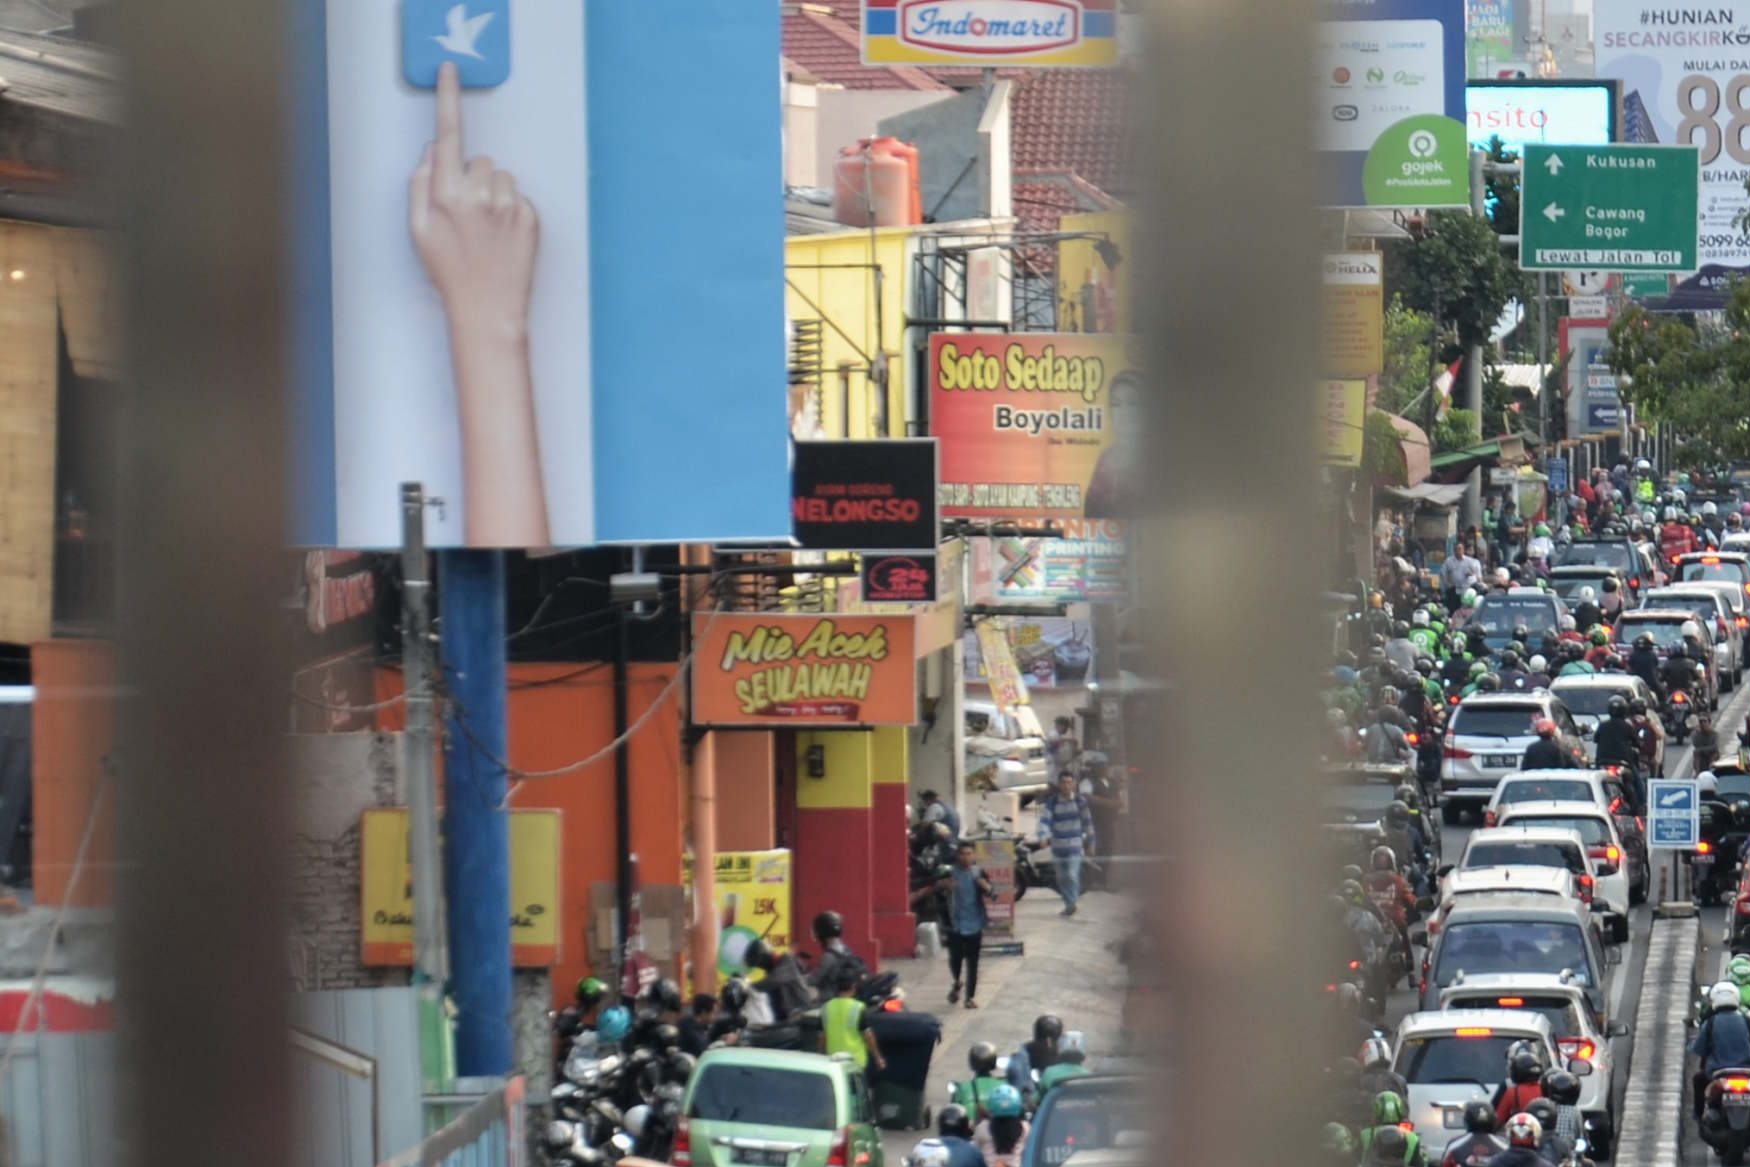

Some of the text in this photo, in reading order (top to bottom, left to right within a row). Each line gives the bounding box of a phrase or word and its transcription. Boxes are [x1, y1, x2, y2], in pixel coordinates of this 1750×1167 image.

[912, 7, 1067, 37] Indomaret
[1640, 9, 1734, 25] #HUNIAN
[1683, 61, 1726, 71] MULAI
[1401, 160, 1444, 176] gojek
[1586, 154, 1657, 169] Kukusan
[1585, 206, 1646, 223] Cawang
[1585, 224, 1629, 240] Bogor
[1540, 250, 1676, 264] Lewat Jalan Tol
[938, 343, 1103, 402] Soto Sedaap
[995, 406, 1102, 434] Boyolali
[721, 619, 888, 670] Mie Aceh
[735, 662, 873, 713] SEULAWAH
